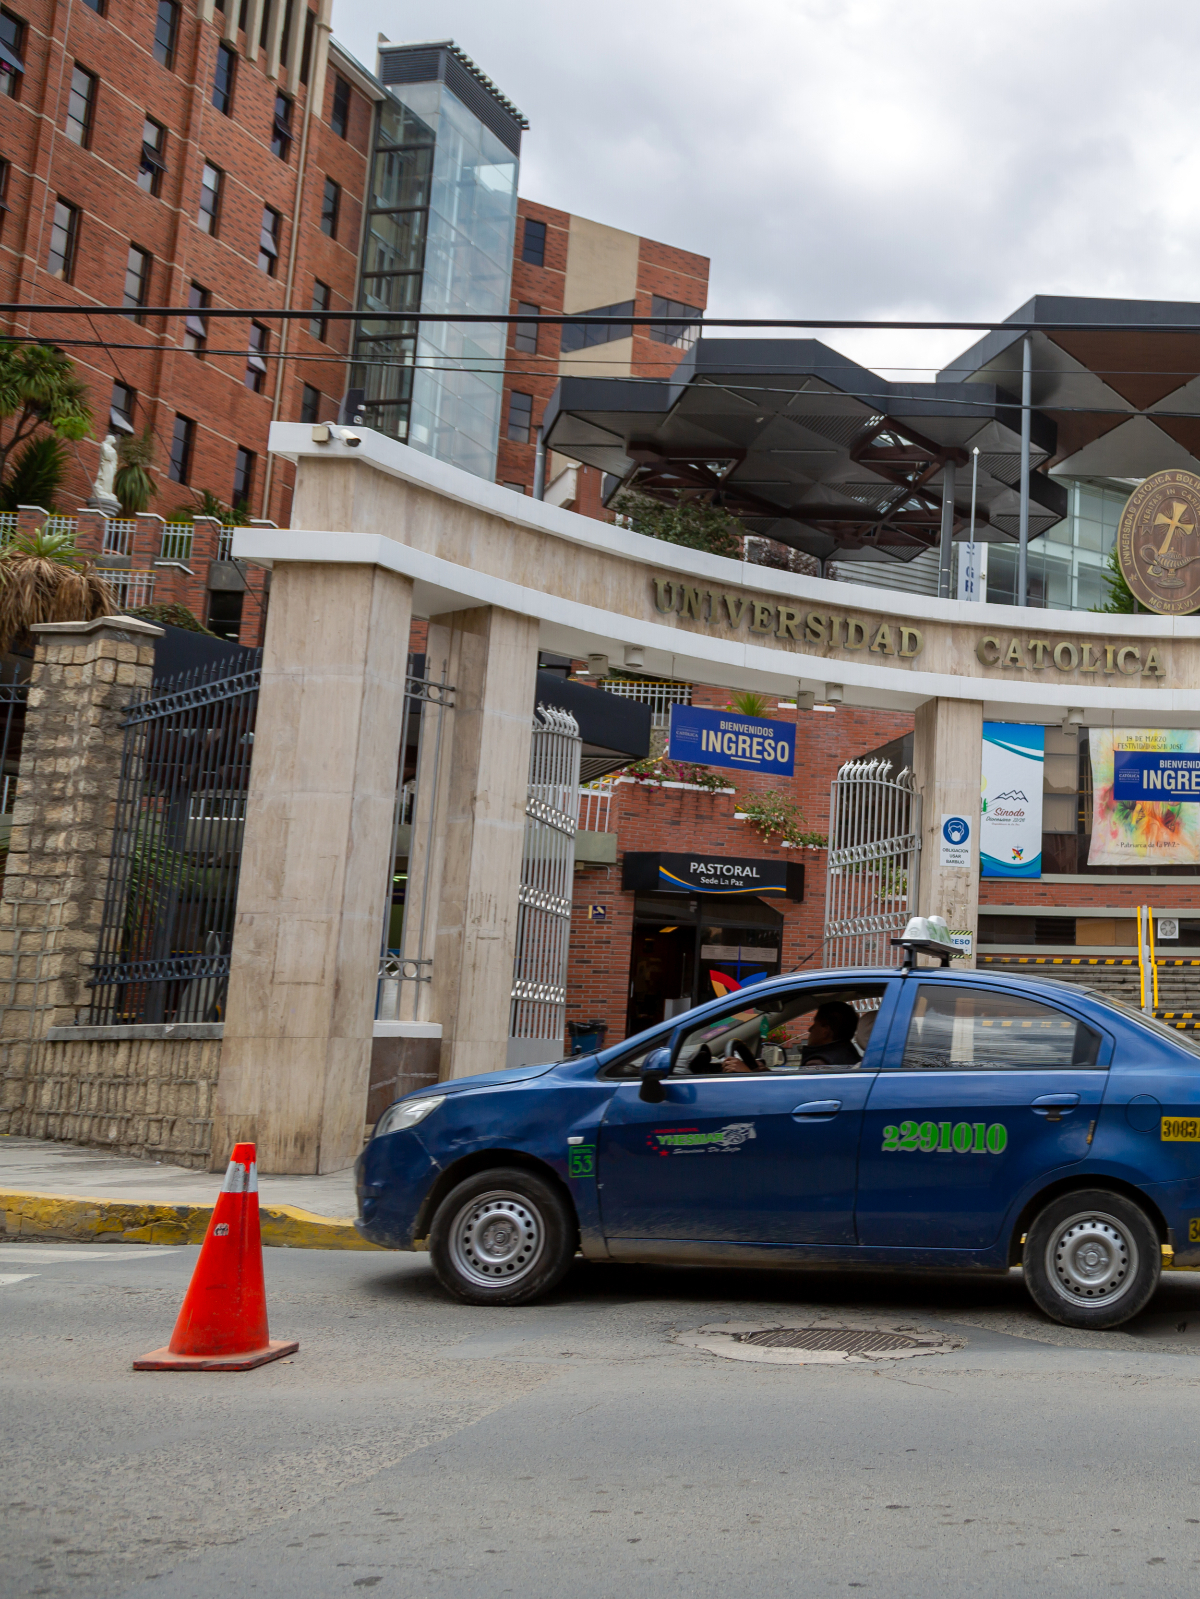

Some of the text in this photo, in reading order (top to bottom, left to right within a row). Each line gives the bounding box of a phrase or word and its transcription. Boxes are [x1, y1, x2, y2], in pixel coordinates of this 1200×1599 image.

[1122, 506, 1137, 566] UNIVERSIDAD
[1134, 474, 1171, 505] CATOLICA
[1142, 493, 1162, 524] VERITAS
[653, 578, 924, 657] UNIVERSIDAD
[976, 636, 1166, 676] CATOLICA
[720, 720, 774, 737] BIENVENIDOS
[702, 730, 789, 762] INGRESO
[690, 862, 760, 878] PASTORAL
[700, 876, 744, 887] Sede La Paz
[881, 1120, 1008, 1154] 2291010
[572, 1155, 592, 1173] 53
